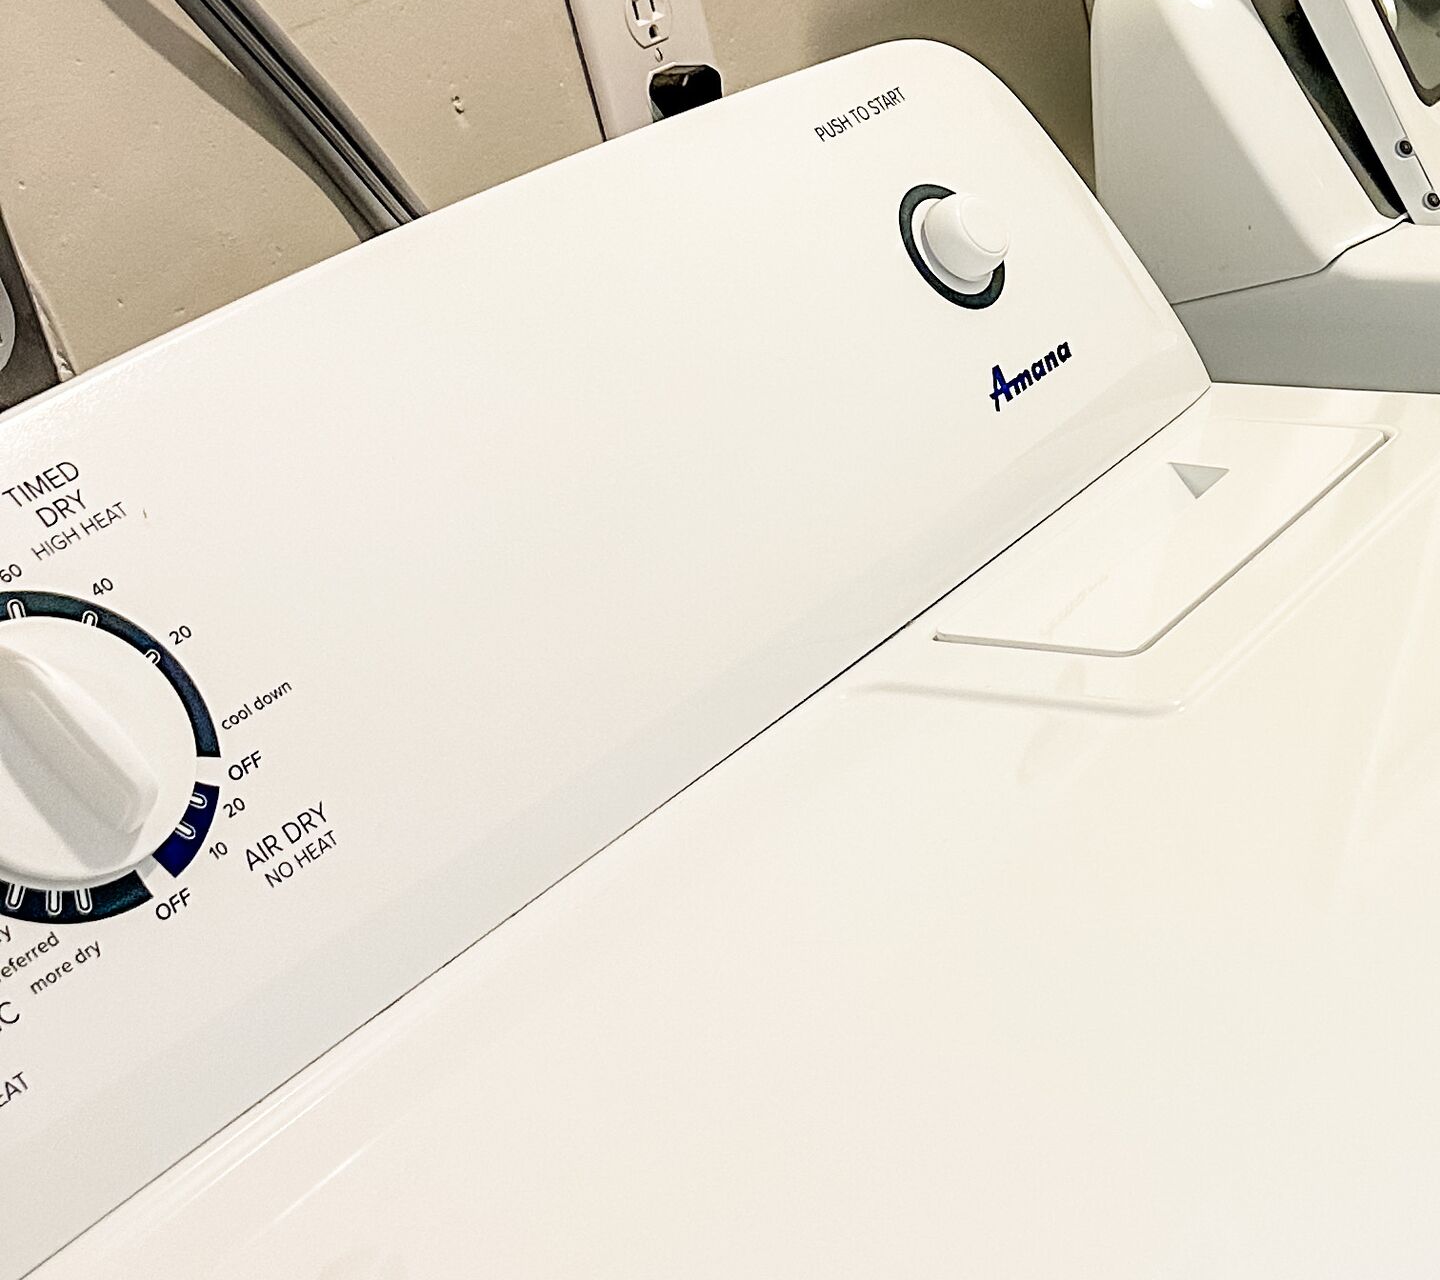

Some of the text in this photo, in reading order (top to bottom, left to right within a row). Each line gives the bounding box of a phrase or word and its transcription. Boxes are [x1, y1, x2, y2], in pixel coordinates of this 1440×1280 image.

[814, 86, 906, 142] PUSH TO START
[989, 341, 1072, 412] Amana
[2, 461, 79, 508] TIMED
[30, 501, 128, 561] HIGH HEAT
[35, 489, 87, 528] DRY
[0, 564, 22, 583] 60
[92, 577, 114, 597] 40
[169, 625, 192, 645] 20
[221, 680, 293, 731] cool down
[228, 751, 262, 781] OFF
[223, 797, 246, 819] 20
[208, 841, 228, 860] 10
[244, 801, 328, 871] AIR DRY
[264, 830, 339, 888] NO HEAT
[155, 887, 192, 921] OFF
[0, 931, 60, 982] eferred
[30, 940, 101, 995] more dry
